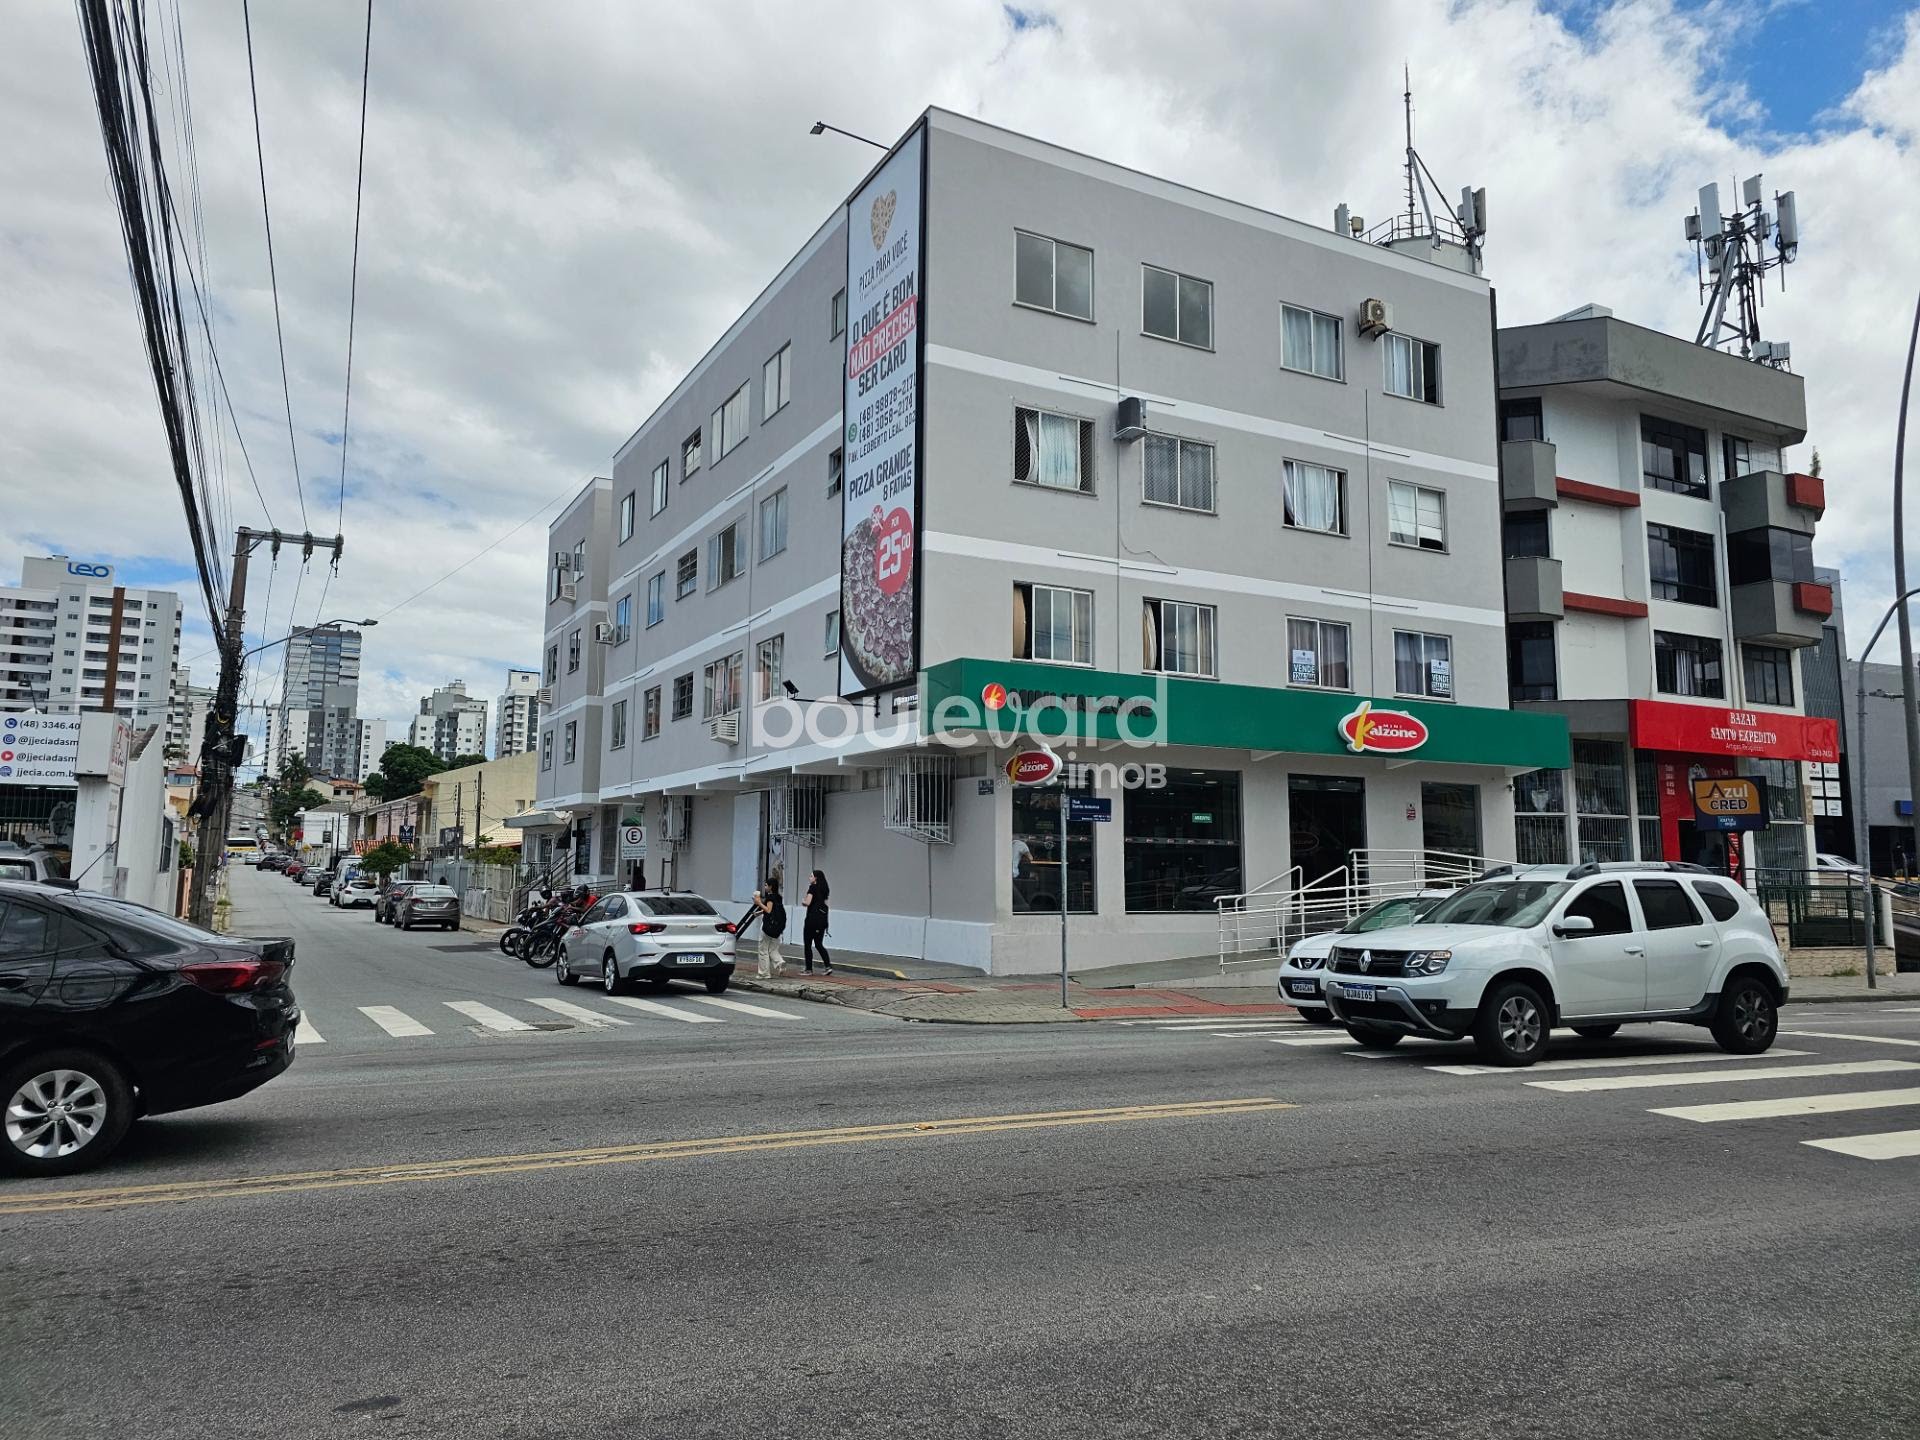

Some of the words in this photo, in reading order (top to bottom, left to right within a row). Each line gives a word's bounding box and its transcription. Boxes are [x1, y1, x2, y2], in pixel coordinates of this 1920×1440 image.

[859, 265, 875, 293] PIZZA
[875, 250, 891, 276] PARA
[853, 320, 860, 344] O
[861, 300, 881, 337] QUE
[883, 288, 890, 318] É
[892, 270, 914, 311] BOM
[850, 339, 871, 376] NÃO
[872, 302, 916, 359] PRECISA
[858, 362, 878, 398] SER
[880, 341, 907, 381] CARO
[859, 404, 874, 426] (48)
[859, 432, 887, 458] LEOBERTO
[849, 468, 875, 502] PIZZA
[876, 442, 913, 486] GRANDE
[883, 484, 888, 502] 8
[889, 469, 912, 499] FATIAS
[891, 515, 900, 527] POR
[878, 528, 903, 582] 25
[1293, 663, 1316, 674] VENDE
[1431, 673, 1450, 684] VENDE
[19, 719, 40, 730] (48)
[1730, 712, 1757, 727] BAZAR
[1711, 727, 1737, 741] SANTO
[1738, 730, 1777, 745] EXPEDITO
[1702, 782, 1749, 800] Azul
[1710, 799, 1748, 811] CRED
[630, 830, 638, 841] E
